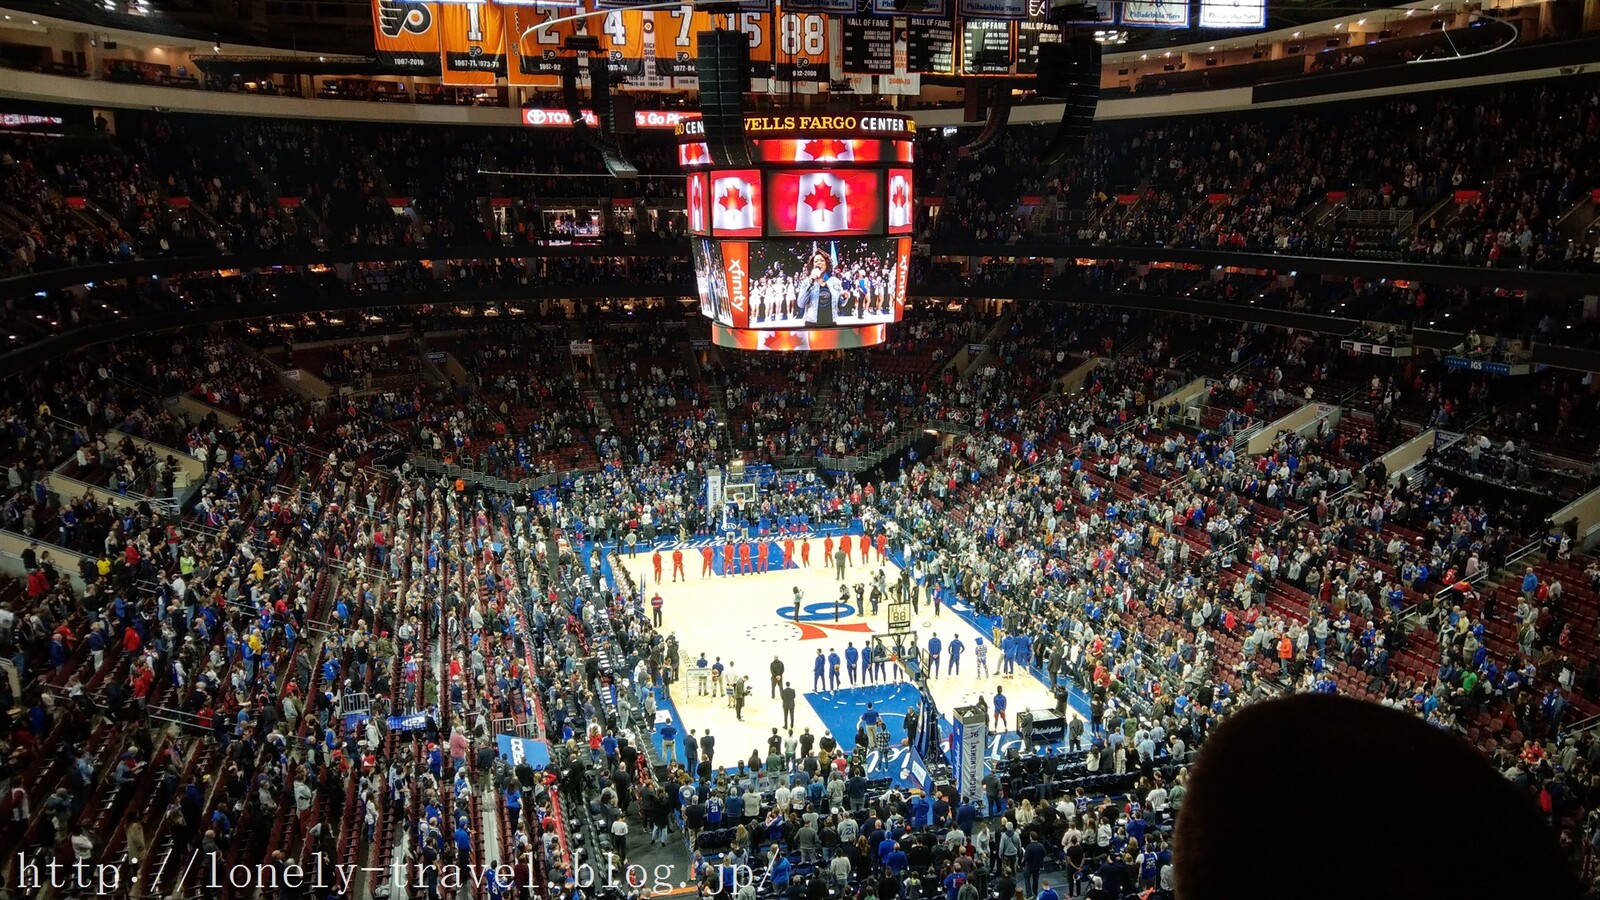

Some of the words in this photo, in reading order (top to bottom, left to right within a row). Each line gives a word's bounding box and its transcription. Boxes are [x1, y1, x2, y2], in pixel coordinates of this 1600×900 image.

[966, 3, 1005, 11] Philadelphia
[1129, 10, 1165, 19] Philadelphia
[466, 3, 482, 41] 1
[536, 7, 560, 45] 2
[603, 9, 626, 46] 4
[671, 5, 694, 47] 7
[847, 18, 862, 26] HALL
[872, 19, 889, 27] FAME
[911, 18, 925, 26] HALL
[934, 20, 951, 28] FAME
[1020, 22, 1035, 30] HALL
[1036, 22, 1044, 30] OF
[781, 13, 825, 56] 88
[647, 113, 665, 125] Go
[799, 116, 857, 130] FARGO
[860, 117, 904, 131] CENTER
[728, 259, 746, 312] xfinity
[896, 254, 909, 305] xfinity
[1470, 361, 1482, 370] IGS
